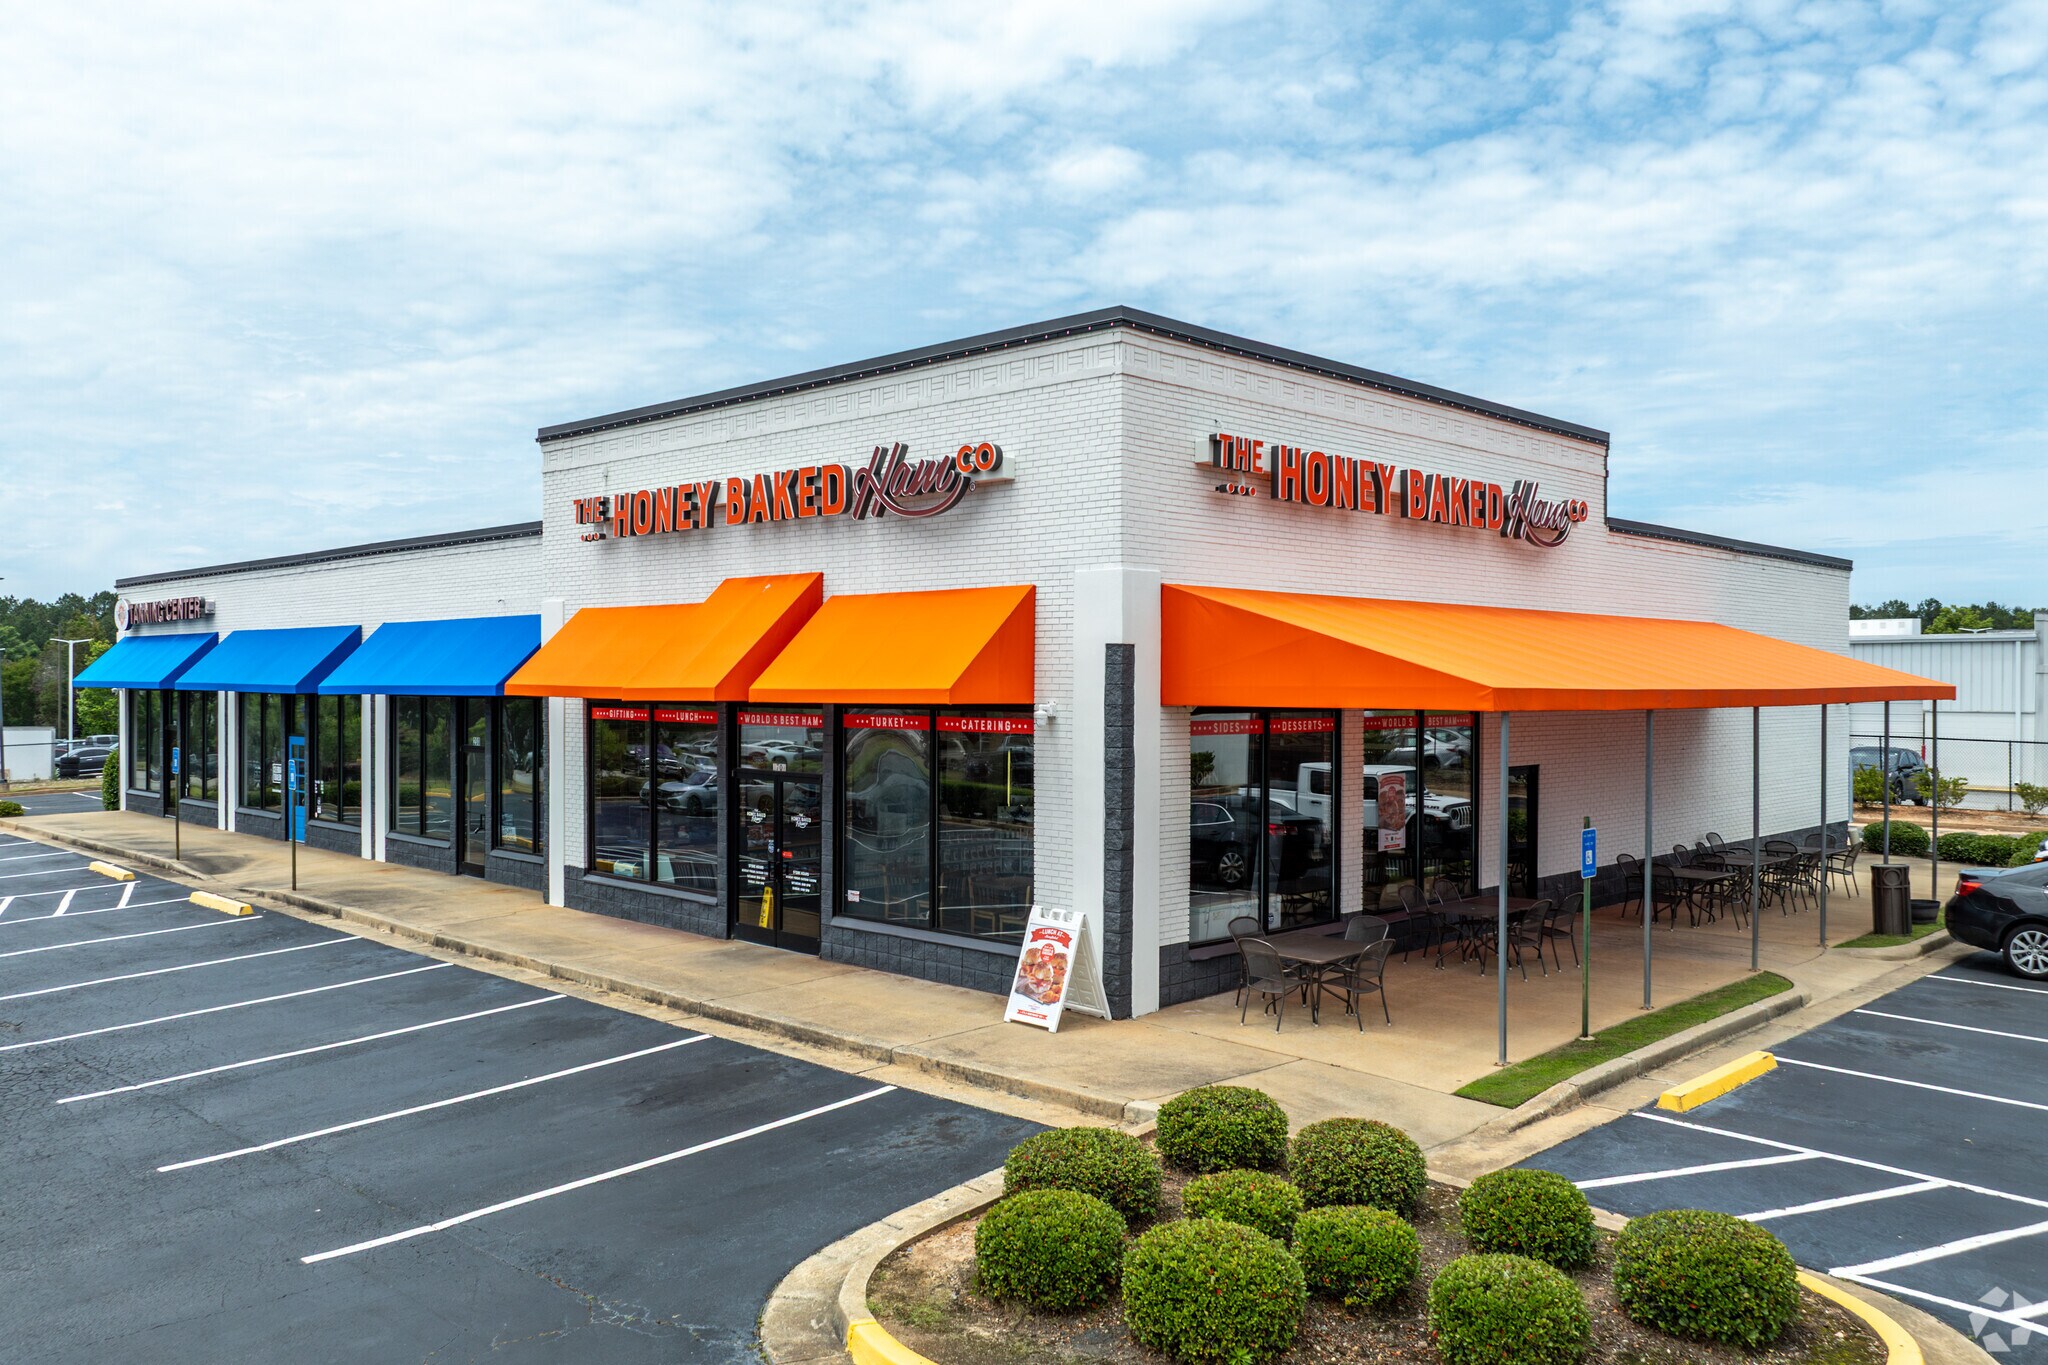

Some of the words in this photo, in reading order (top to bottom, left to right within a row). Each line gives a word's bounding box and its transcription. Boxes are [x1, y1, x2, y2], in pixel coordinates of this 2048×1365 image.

[574, 497, 606, 525] THE
[613, 480, 719, 537] HONEY
[726, 464, 852, 526] BAKED
[852, 442, 970, 520] Ham
[956, 442, 1001, 474] CO
[1213, 433, 1264, 474] THE
[1274, 444, 1396, 515] HONEY
[1403, 468, 1504, 531] BAKED
[1503, 480, 1573, 548] Ham
[130, 601, 164, 625] TANNING
[166, 596, 201, 621] CENTER
[609, 709, 634, 719] GIFTING
[676, 712, 699, 721] LUNCH
[744, 714, 778, 725] WORLD'S
[780, 715, 799, 725] BEST
[801, 716, 819, 726] HAM
[870, 716, 905, 728] TURKEY
[961, 719, 1011, 731] CATERING
[1281, 720, 1323, 732] DESSERTS
[1381, 717, 1413, 728] WORLD'S
[1428, 716, 1443, 726] BEST
[1444, 716, 1457, 726] HAM
[1213, 722, 1240, 734] SIDES
